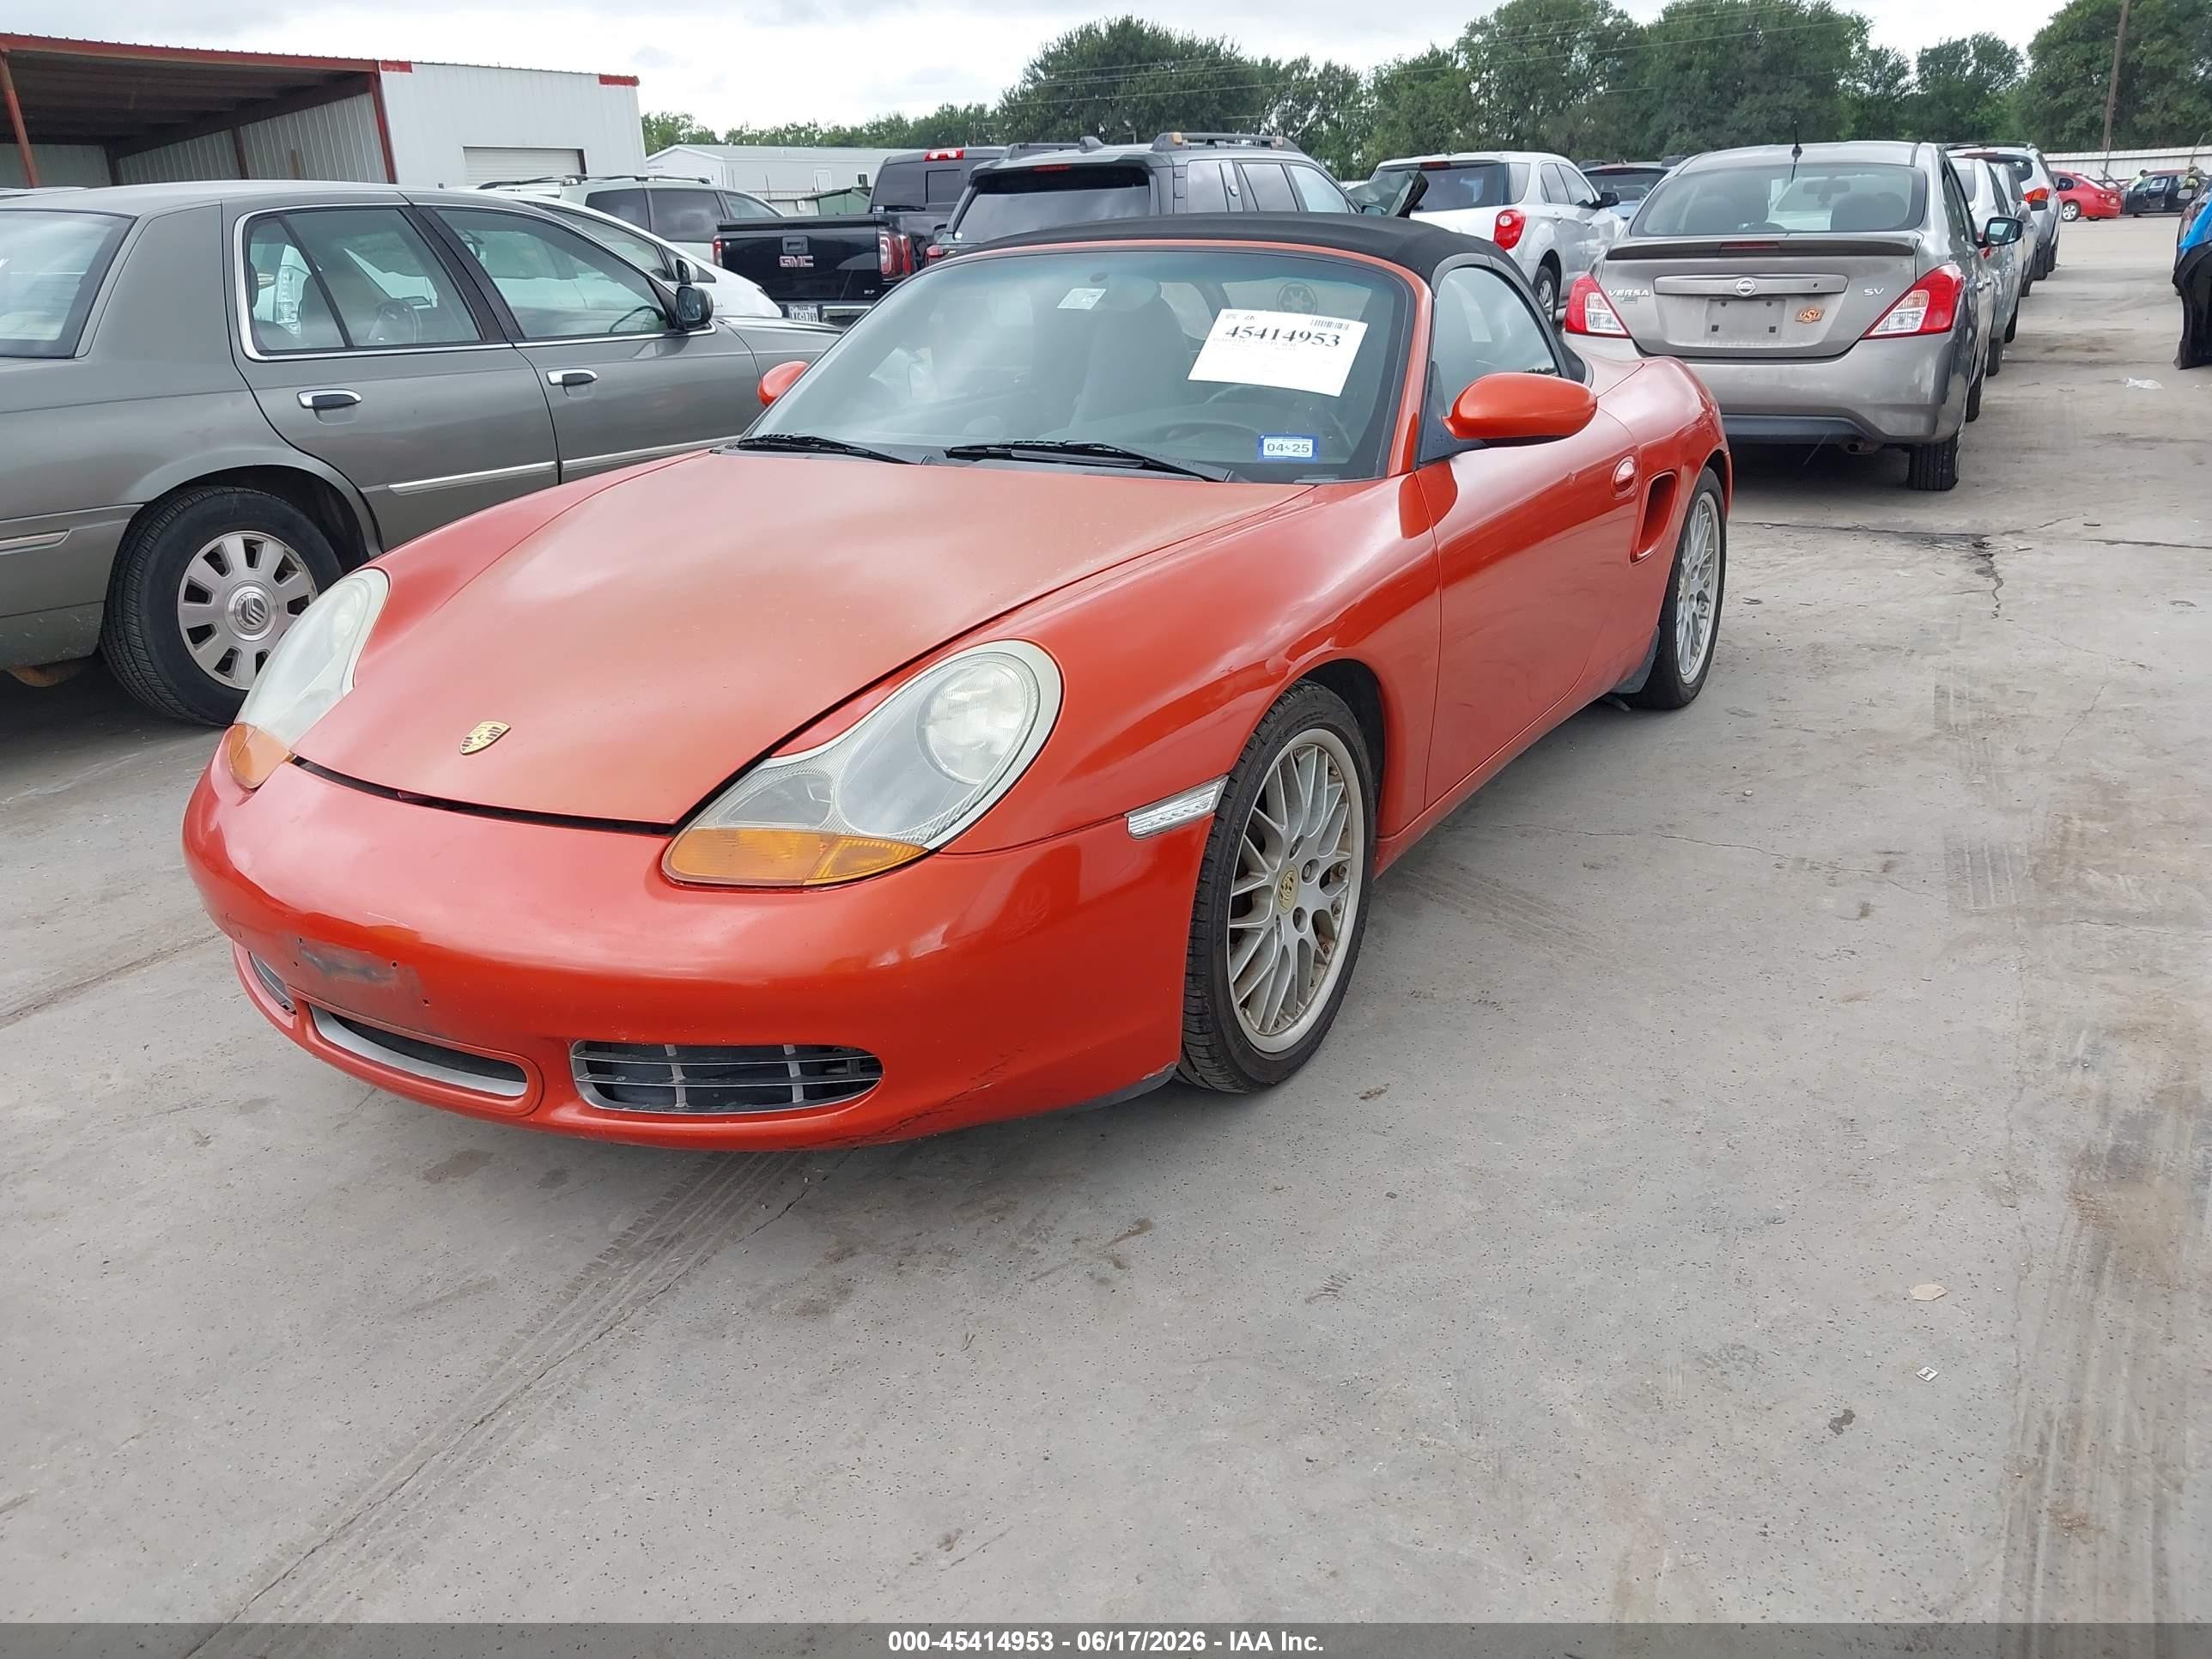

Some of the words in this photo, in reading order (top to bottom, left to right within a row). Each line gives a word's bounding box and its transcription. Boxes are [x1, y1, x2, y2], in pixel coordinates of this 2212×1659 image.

[779, 255, 814, 267] GMC
[1863, 288, 1884, 296] SV
[1225, 325, 1341, 348] 45414953
[1267, 443, 1284, 452] 04
[1291, 443, 1310, 453] 25
